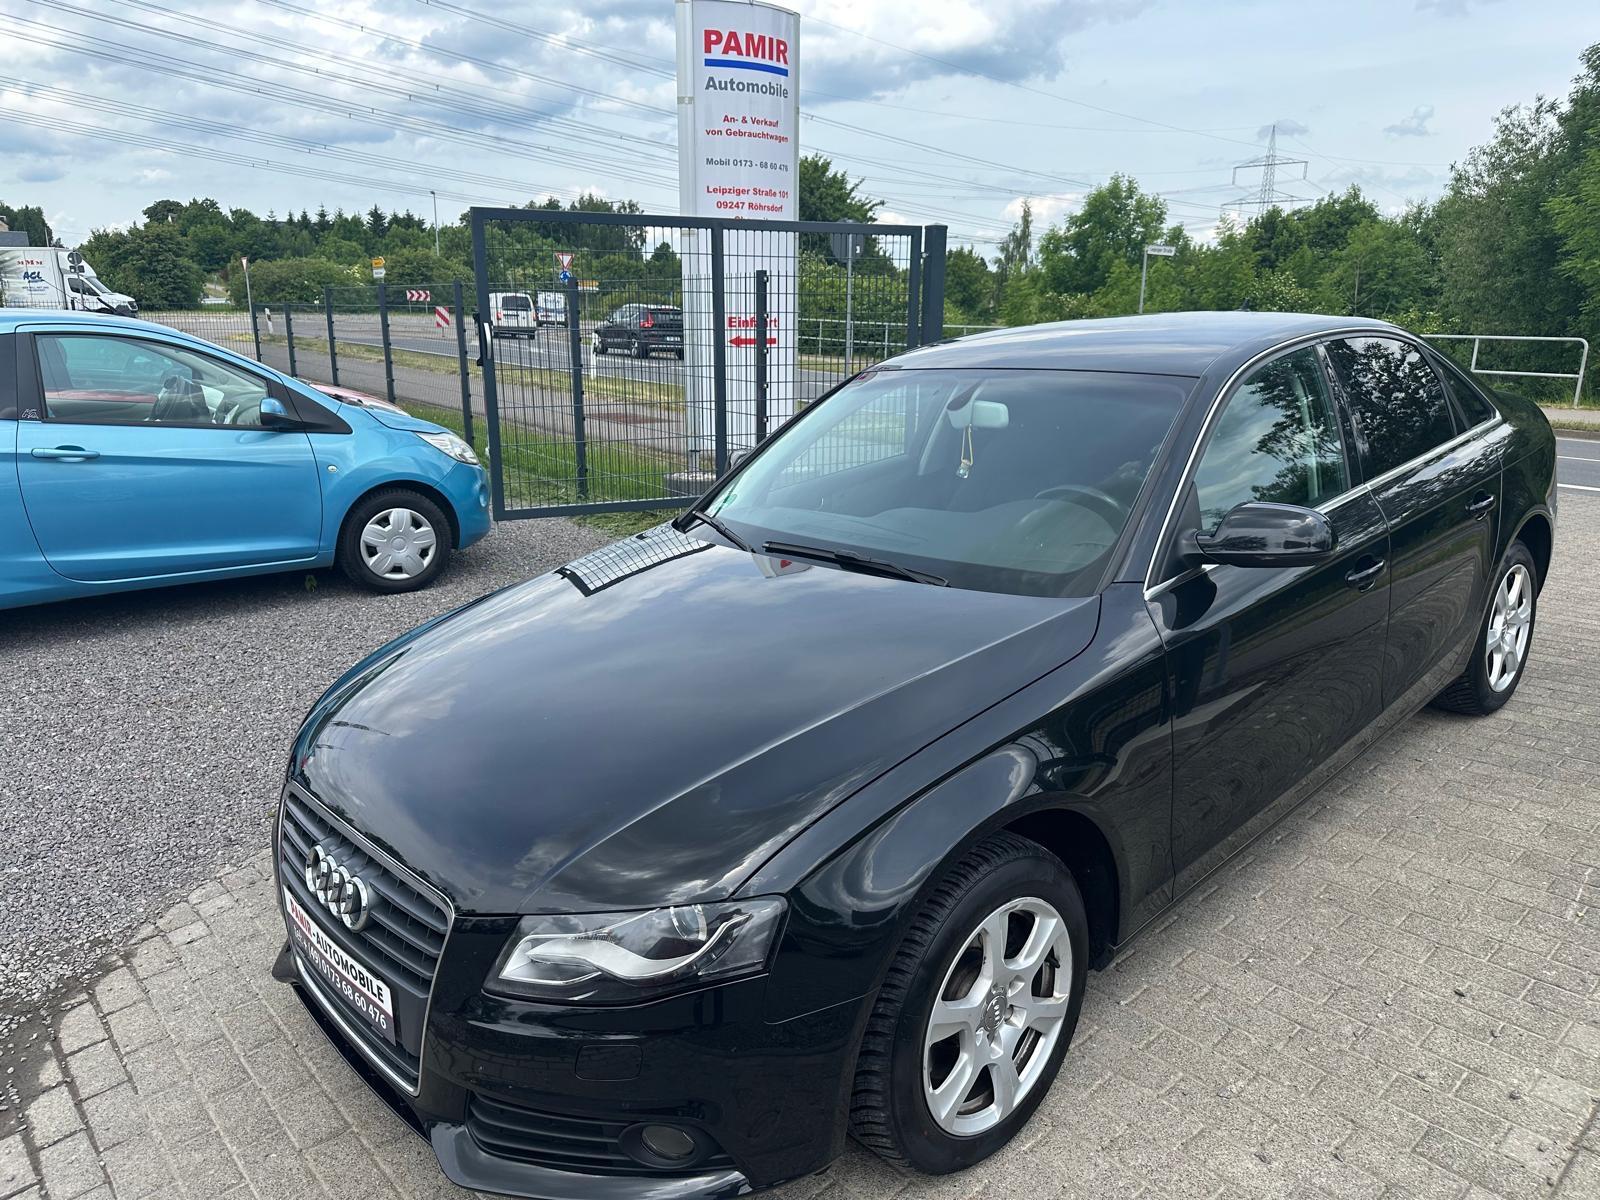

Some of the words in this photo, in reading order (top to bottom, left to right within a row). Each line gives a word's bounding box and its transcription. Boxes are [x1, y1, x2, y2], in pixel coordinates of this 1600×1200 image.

[704, 29, 789, 66] PAMIR
[704, 76, 789, 99] Automobile
[723, 115, 738, 123] An-
[741, 116, 748, 124] &
[750, 117, 779, 128] Verkauf
[725, 128, 789, 143] Gebrauchtwagen
[705, 158, 730, 167] Mobil
[732, 158, 753, 168] 0173
[759, 161, 768, 169] 68
[769, 163, 777, 171] 60
[778, 164, 789, 172] 476
[706, 185, 750, 197] Leipziger
[752, 187, 777, 198] Straße
[779, 190, 789, 199] 101
[716, 201, 746, 210] 09247
[747, 202, 783, 212] Röhrsdorf
[728, 316, 778, 328] Einfrt
[321, 961, 341, 989] 0173
[341, 980, 354, 1001] 68
[354, 992, 367, 1012] 60
[368, 1003, 387, 1030] 476
